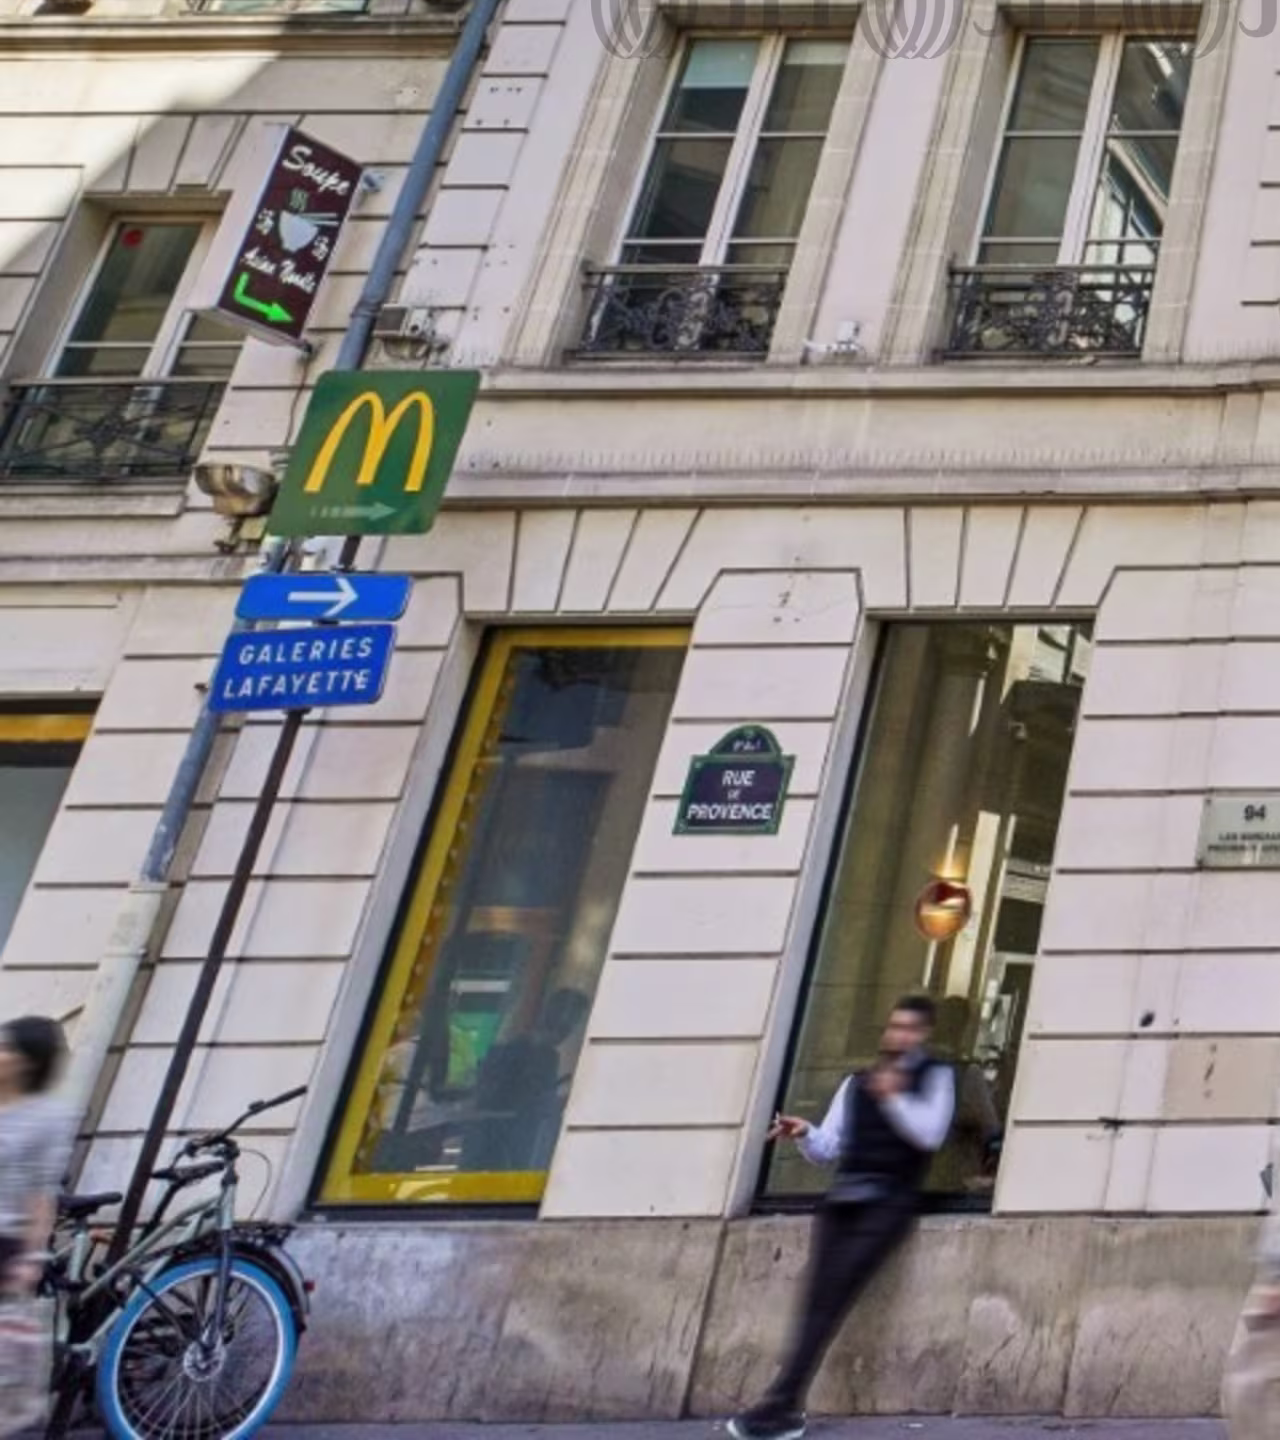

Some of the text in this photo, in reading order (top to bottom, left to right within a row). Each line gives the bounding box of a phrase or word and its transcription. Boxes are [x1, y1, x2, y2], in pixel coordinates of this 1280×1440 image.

[282, 145, 350, 195] Soupe
[239, 637, 373, 665] GALERIES
[223, 669, 371, 699] LAFAYETTE
[722, 770, 755, 786] RUE
[687, 803, 773, 820] PROVENCE
[1244, 804, 1266, 821] 94
